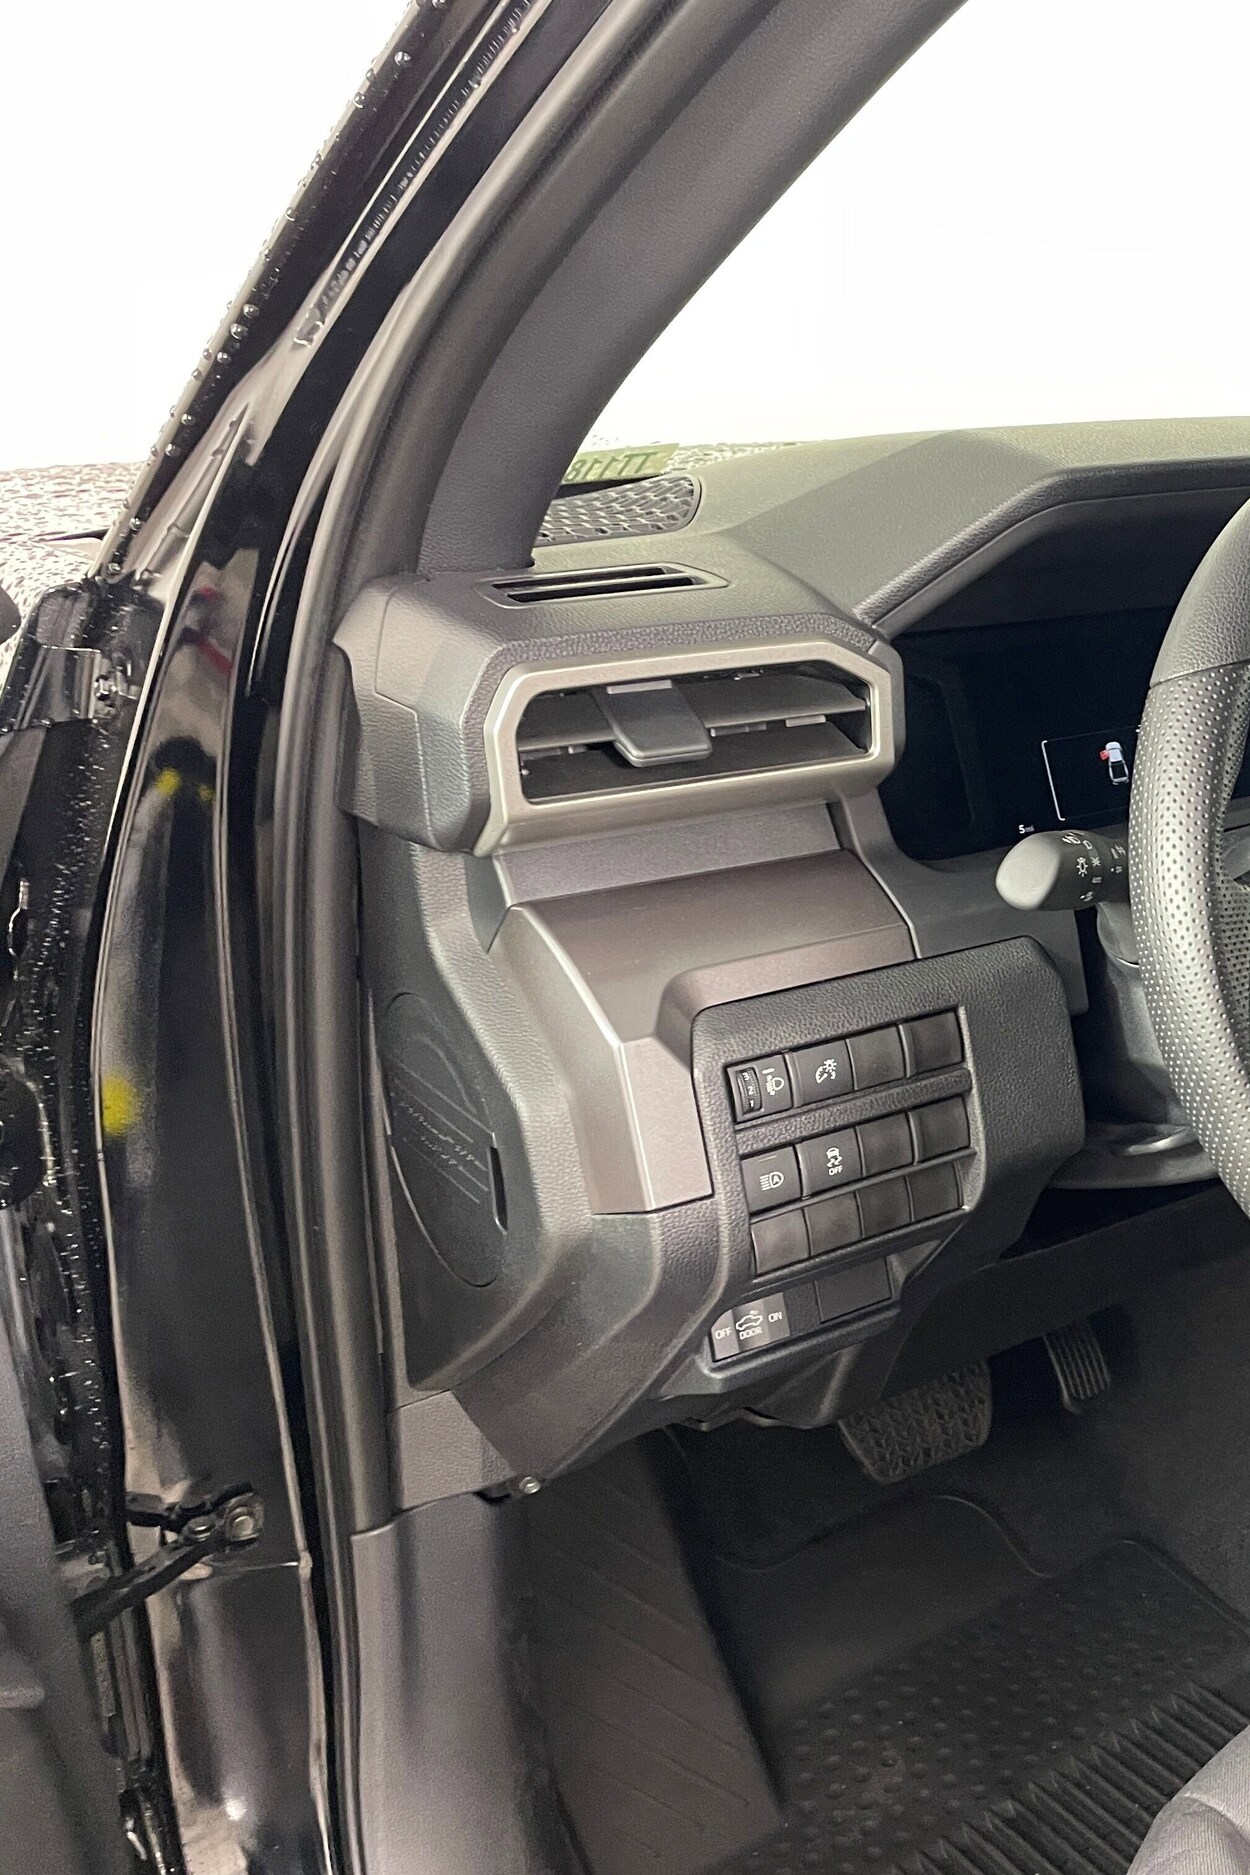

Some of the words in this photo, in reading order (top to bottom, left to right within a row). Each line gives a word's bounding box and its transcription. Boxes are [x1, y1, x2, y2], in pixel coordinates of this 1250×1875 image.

[747, 1085, 755, 1096] 2
[749, 1099, 755, 1108] 1
[828, 1165, 843, 1176] OFF
[768, 1311, 783, 1323] ON
[714, 1326, 732, 1340] OFF
[739, 1326, 763, 1340] DOOR
